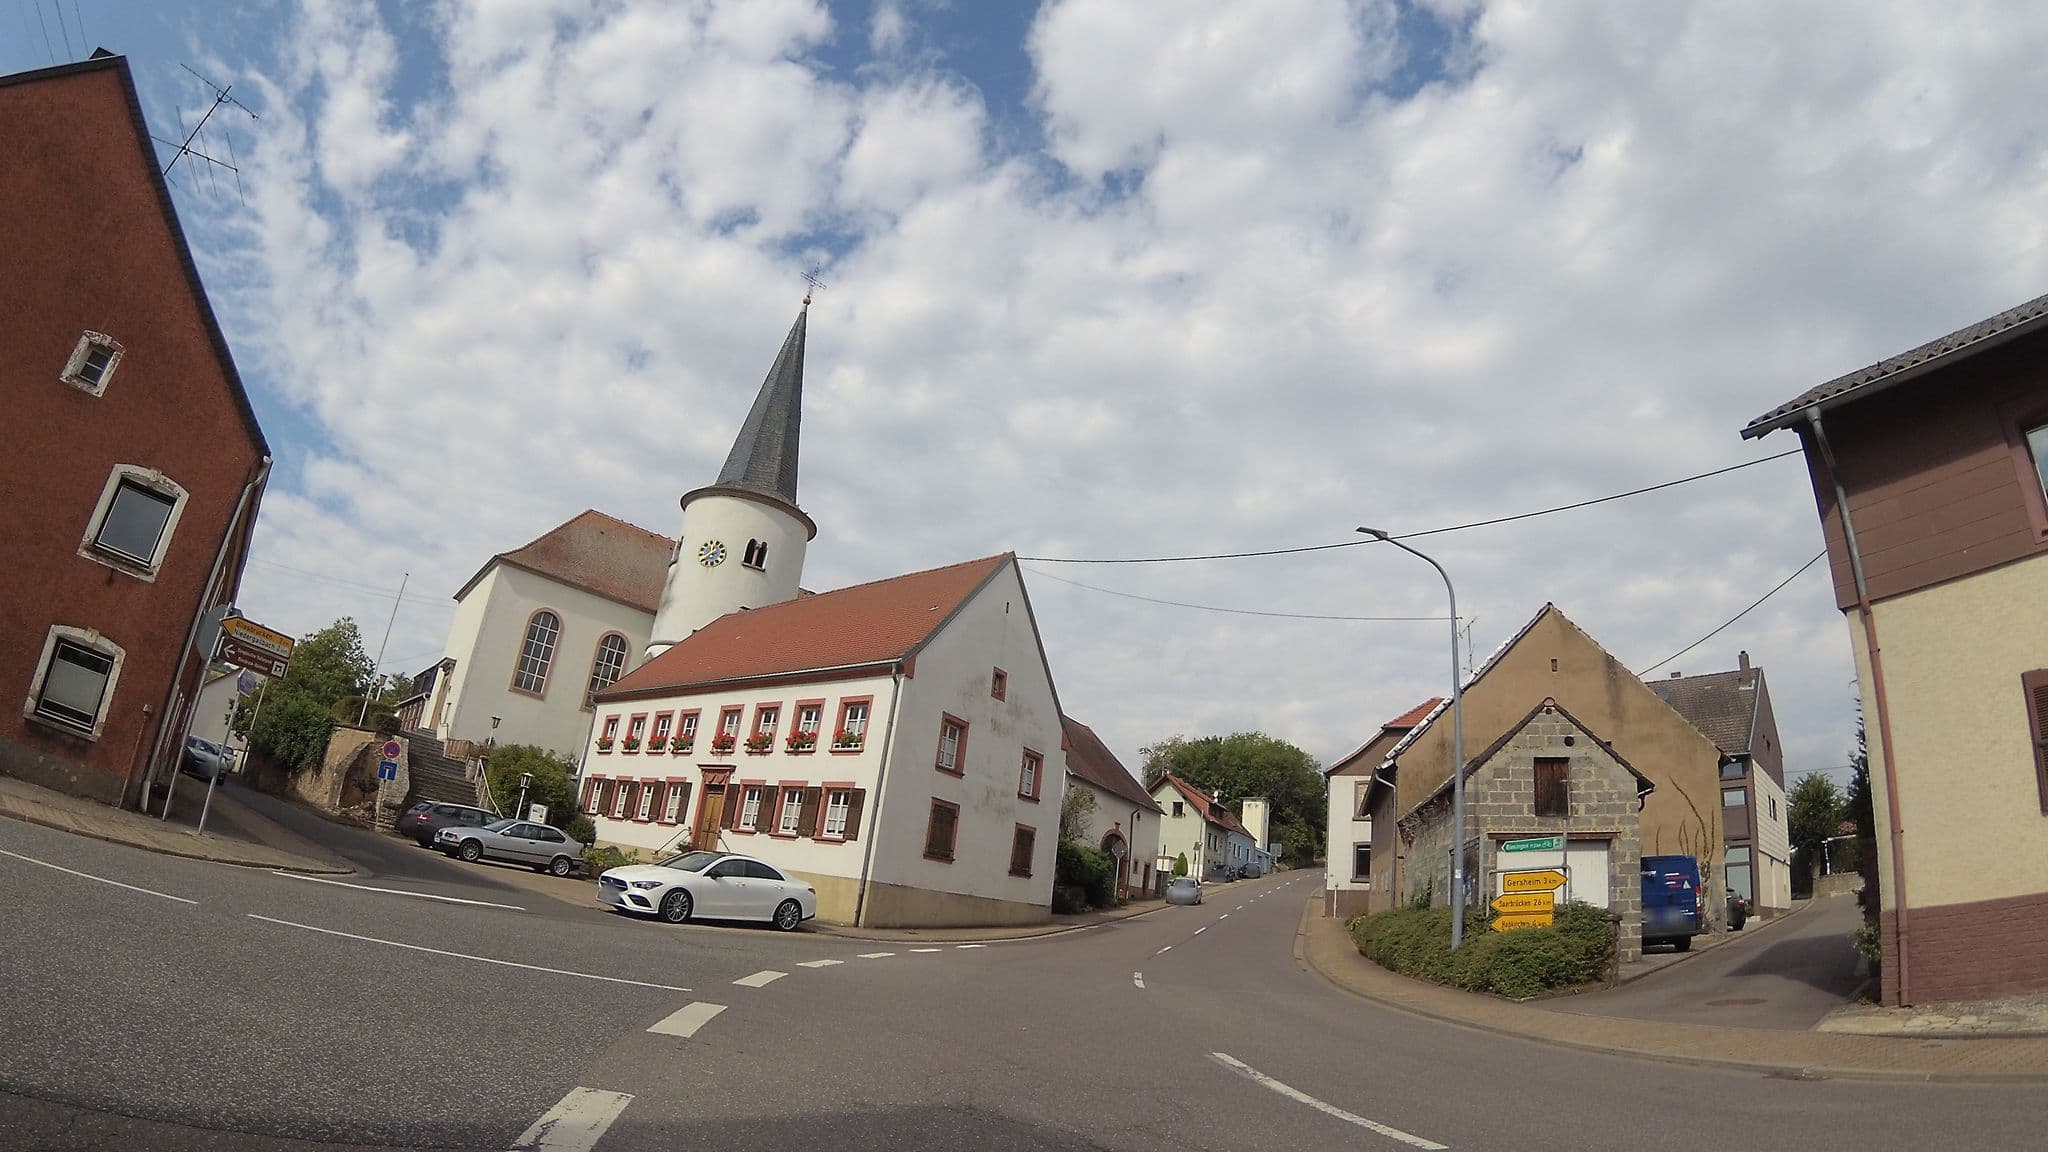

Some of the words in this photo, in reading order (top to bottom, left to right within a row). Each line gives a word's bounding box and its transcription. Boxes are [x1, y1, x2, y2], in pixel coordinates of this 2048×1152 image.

[1507, 878, 1541, 887] Gersheim
[1543, 877, 1548, 885] 3
[1499, 899, 1531, 908] Saarbrücken
[1534, 898, 1542, 906] 26
